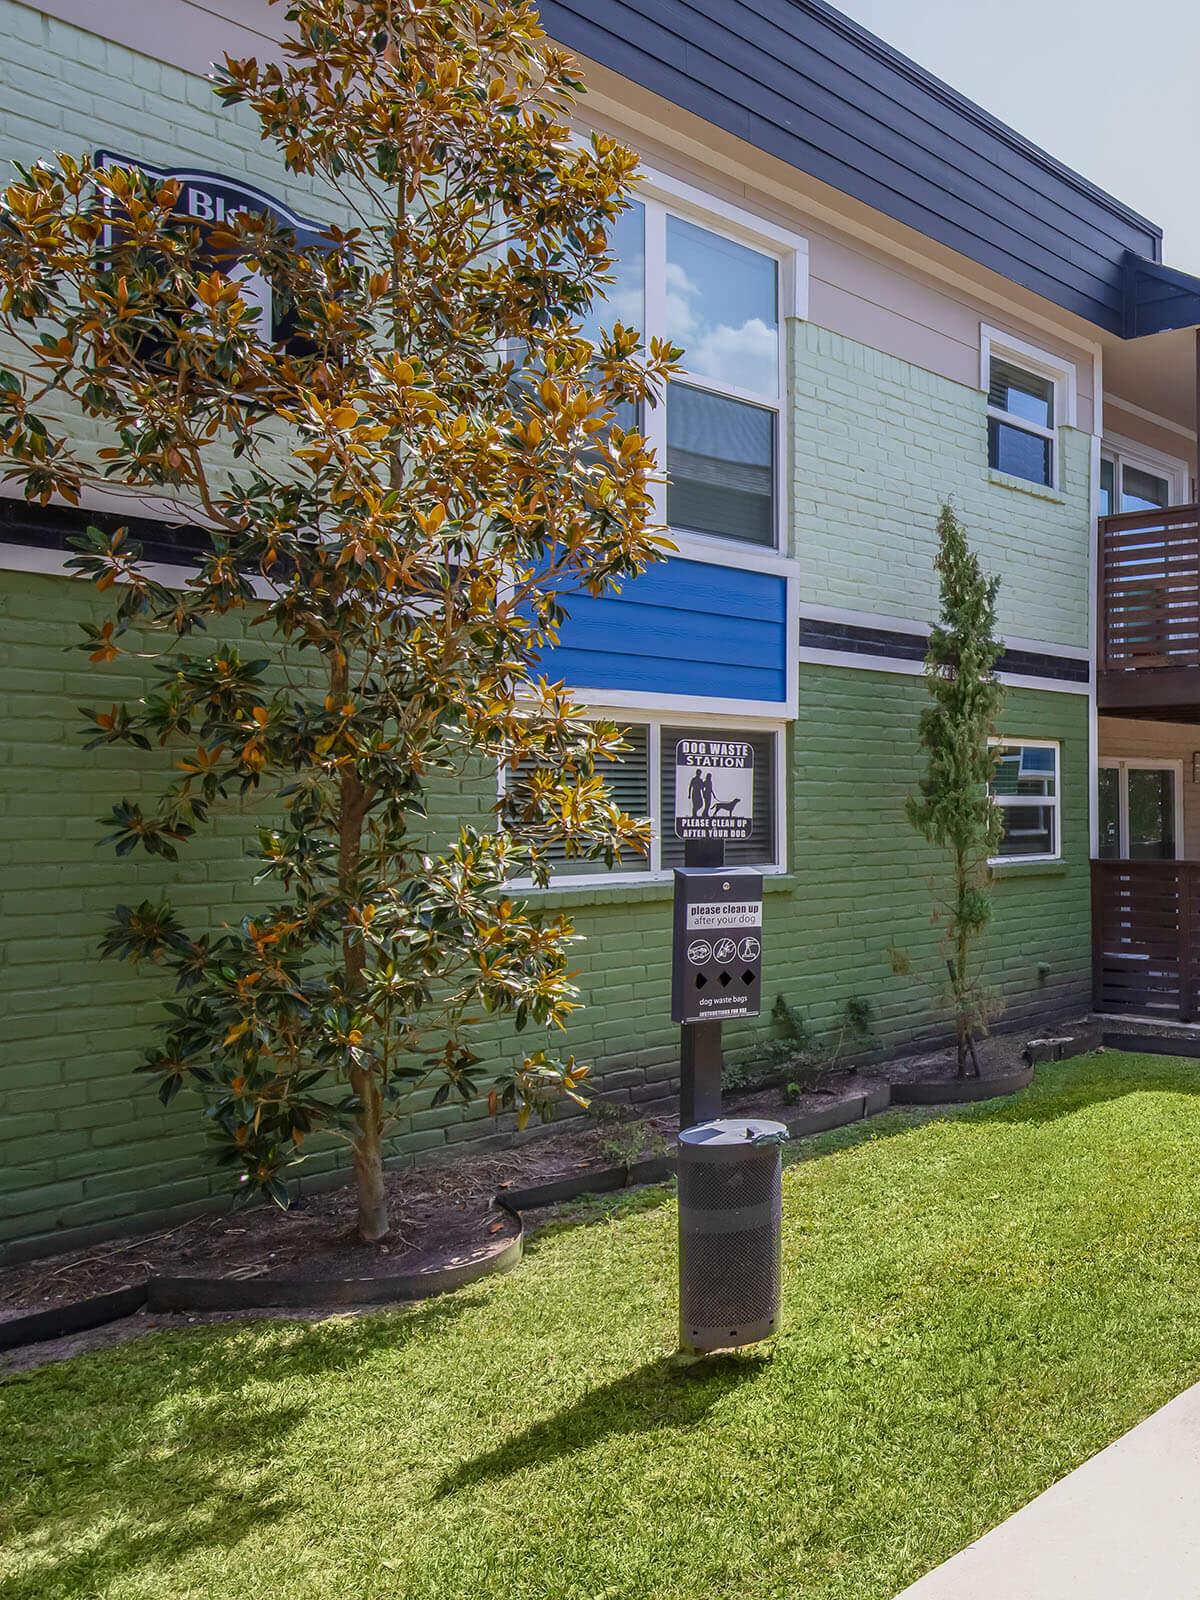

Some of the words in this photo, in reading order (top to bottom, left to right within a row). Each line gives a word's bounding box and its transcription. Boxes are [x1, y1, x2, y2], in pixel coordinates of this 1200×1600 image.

[682, 742, 706, 754] DOG
[710, 744, 748, 756] WASTE
[686, 756, 744, 767] STATION
[682, 819, 709, 827] PLEASE
[712, 819, 734, 827] CLEAN
[691, 906, 720, 916] please
[723, 905, 746, 914] clean
[748, 905, 758, 914] up
[694, 916, 714, 924] after
[717, 916, 736, 926] your
[739, 914, 756, 924] dog
[699, 998, 712, 1006] dog
